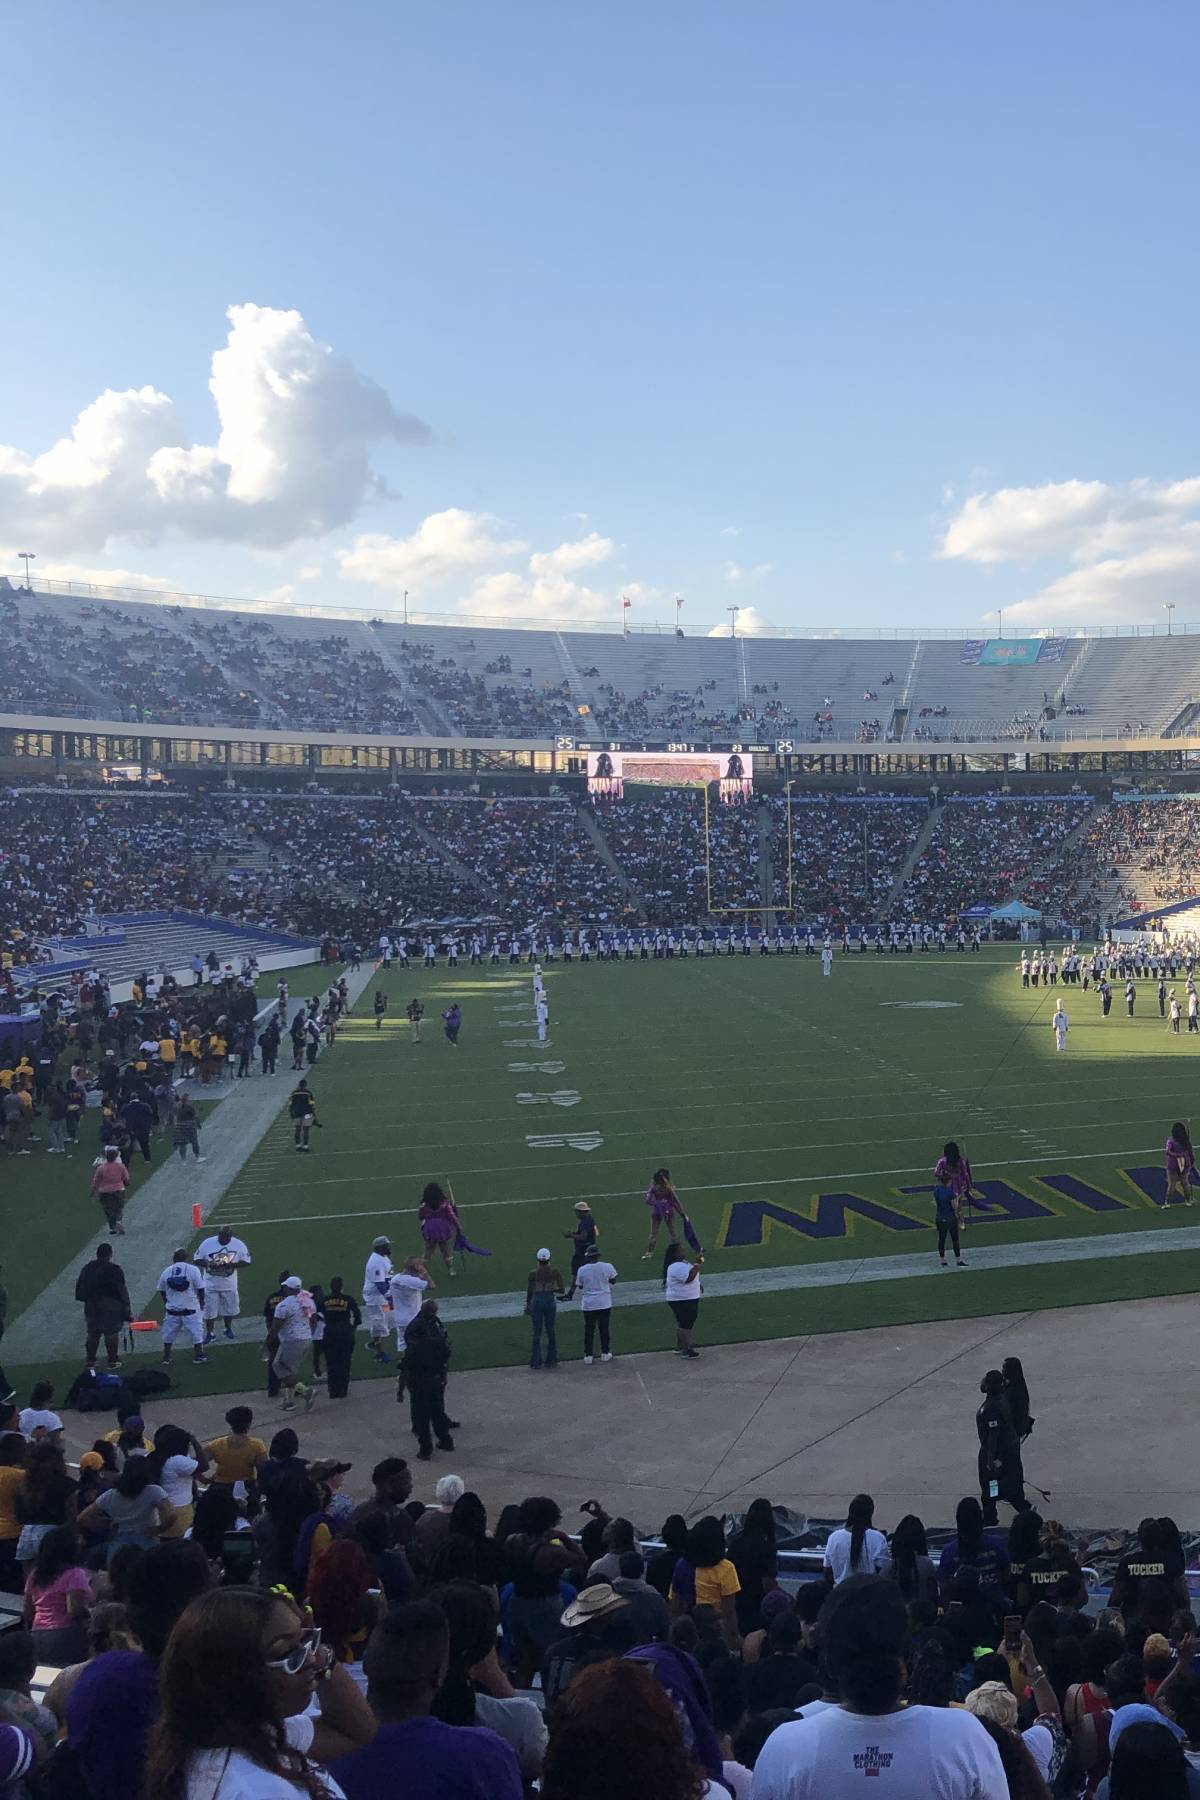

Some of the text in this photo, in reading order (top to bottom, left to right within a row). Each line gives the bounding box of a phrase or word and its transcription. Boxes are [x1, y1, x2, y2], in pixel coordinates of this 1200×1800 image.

[557, 738, 573, 749] 25
[609, 743, 620, 751] 31
[778, 741, 793, 752] 25
[1128, 1563, 1165, 1576] TUCKER
[853, 1752, 894, 1760] MARATHON
[854, 1760, 891, 1768] CLOTHING
